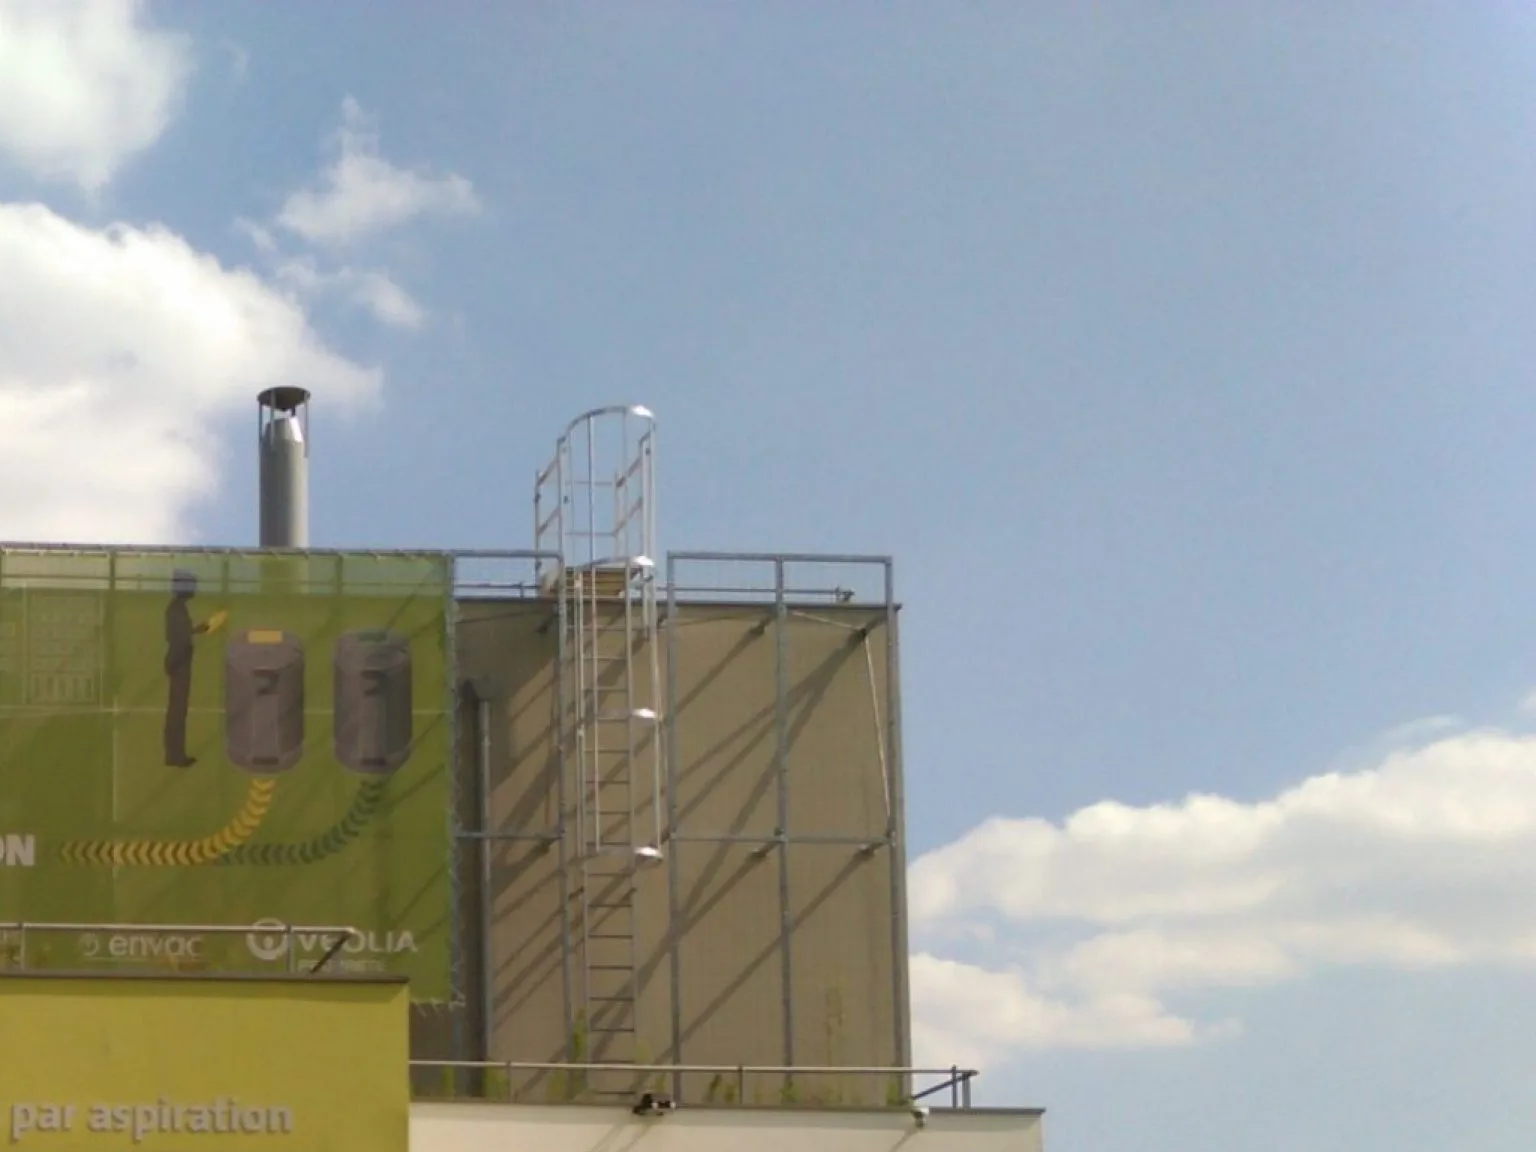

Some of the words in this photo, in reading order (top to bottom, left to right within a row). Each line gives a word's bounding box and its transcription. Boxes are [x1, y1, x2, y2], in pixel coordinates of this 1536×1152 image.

[107, 933, 204, 958] envac
[296, 930, 419, 954] VEOLIA
[9, 1098, 76, 1143] par
[88, 1095, 295, 1143] aspiration
